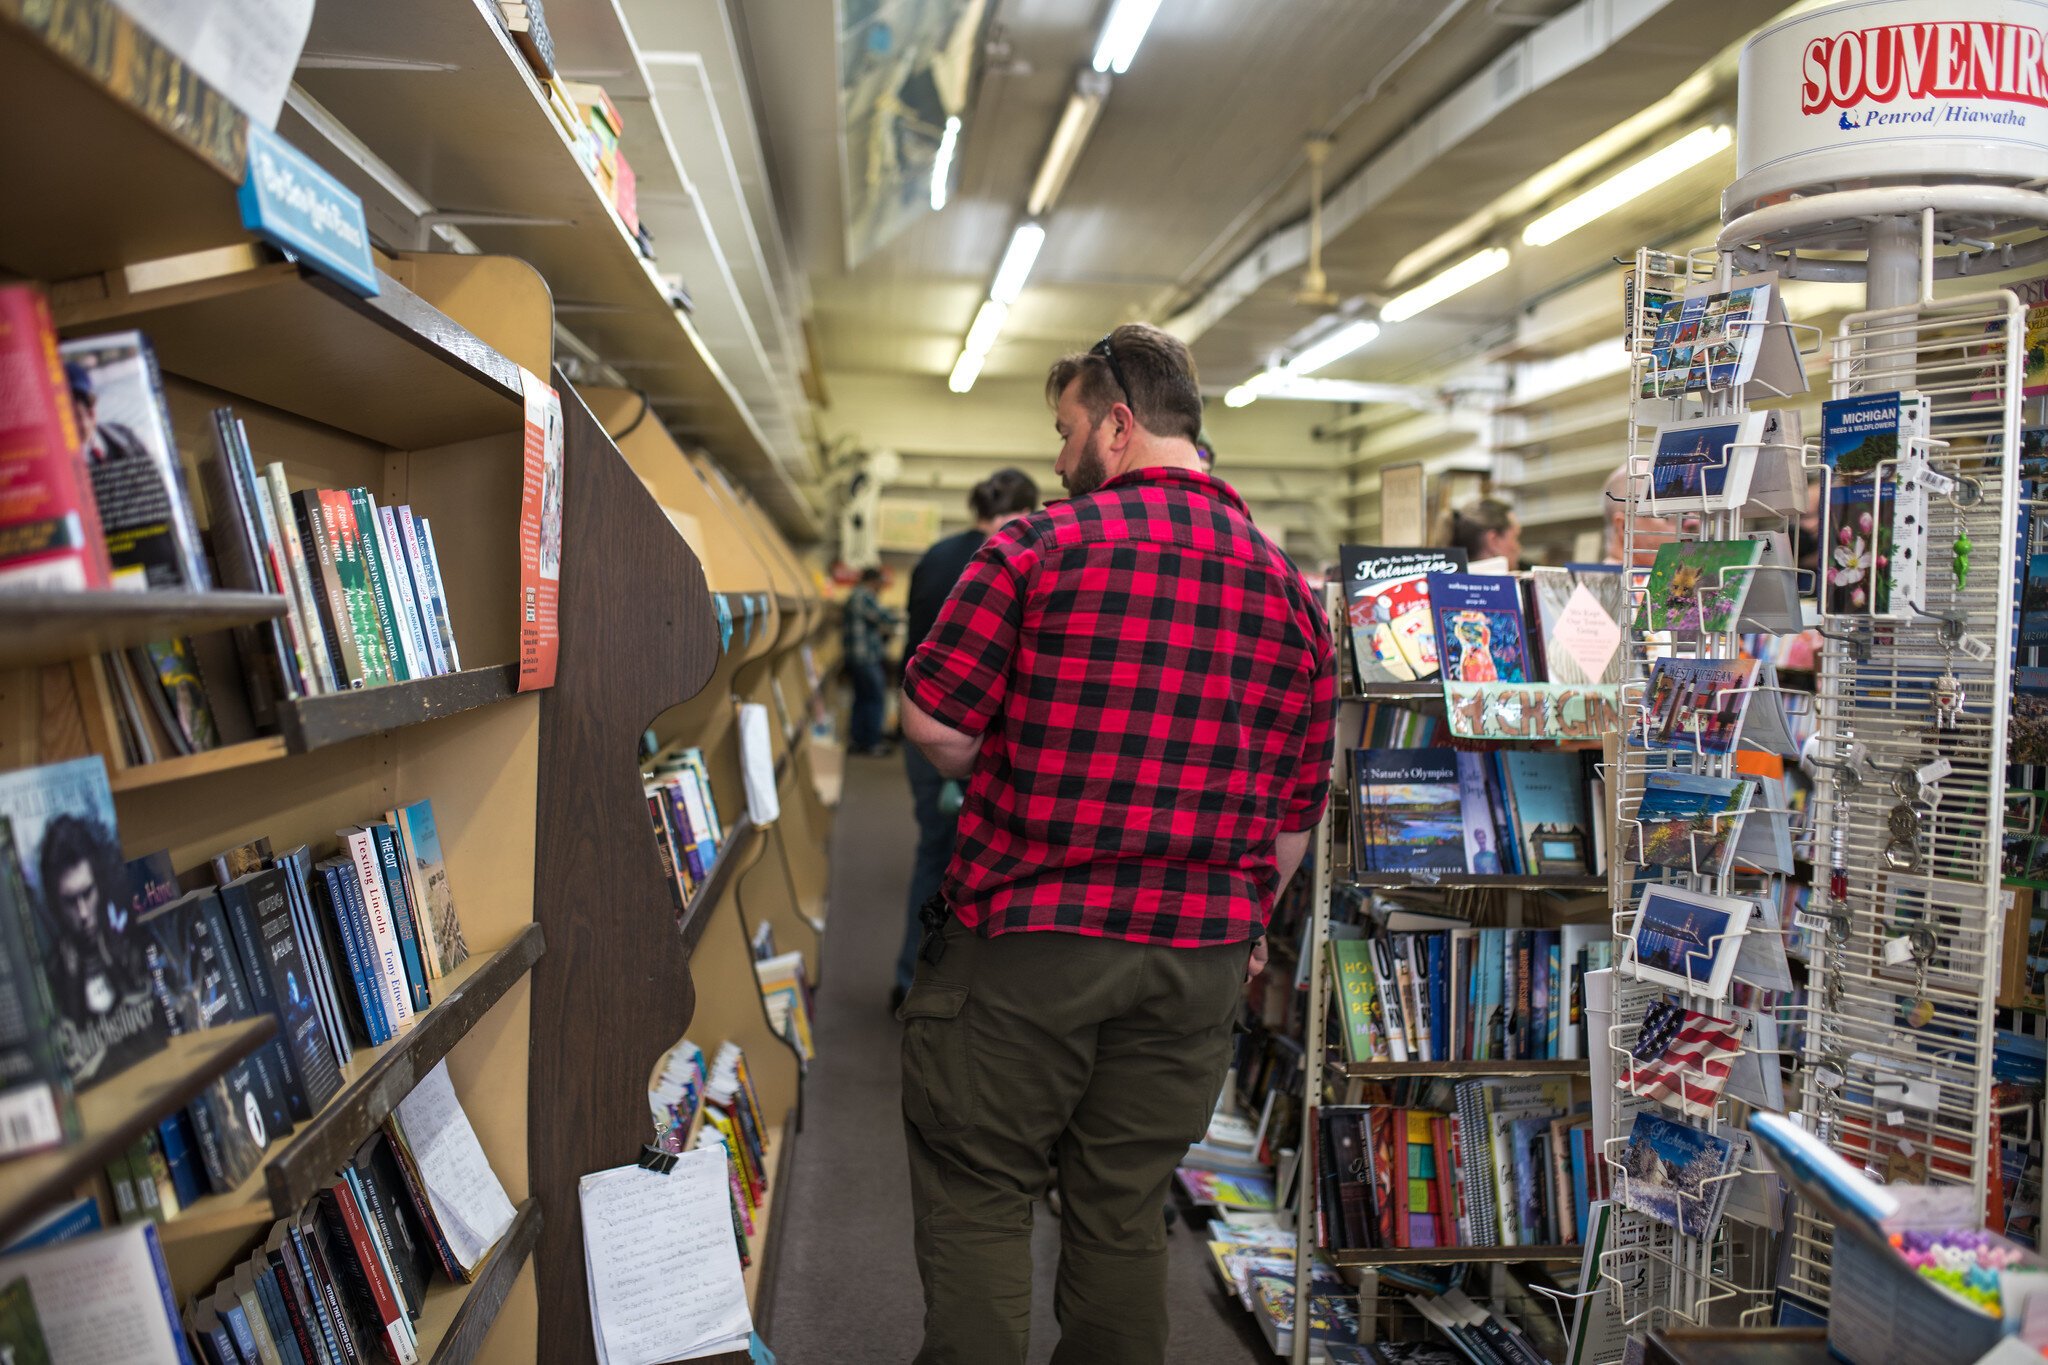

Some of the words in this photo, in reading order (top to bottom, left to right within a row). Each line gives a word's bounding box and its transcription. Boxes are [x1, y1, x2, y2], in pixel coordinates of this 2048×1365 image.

[1830, 427, 1847, 435] TREES
[1854, 421, 1896, 433] WILDFLOWERS
[1842, 408, 1896, 425] MICHIGAN
[311, 508, 324, 534] Letters
[318, 535, 326, 544] to
[385, 513, 393, 526] FIND
[389, 527, 397, 544] YOUR
[393, 544, 402, 561] VOICE
[403, 511, 411, 525] FIND
[407, 526, 415, 542] YOUR
[411, 542, 419, 559] VOICE
[2026, 523, 2035, 566] MICHIGAN
[319, 544, 332, 566] Corey
[361, 532, 378, 571] NEGROES
[371, 571, 380, 582] IN
[417, 536, 428, 557] Moon
[423, 563, 434, 582] Back
[429, 586, 438, 598] Me
[1355, 560, 1458, 580] Kalamazoo
[373, 583, 391, 625] MICHIGAN
[408, 606, 418, 631] DIANNA
[414, 631, 424, 652] LEEDER
[425, 604, 435, 628] DIANNA
[431, 628, 441, 649] LEEDER
[383, 626, 400, 663] HISTORY
[1669, 666, 1691, 680] WEST
[1693, 668, 1734, 682] MICHIGAN
[1371, 768, 1409, 780] Nature's
[1410, 767, 1454, 781] Olympics
[380, 837, 394, 854] THE
[383, 852, 398, 870] CUT
[389, 877, 404, 897] JOHN
[351, 911, 367, 948] CLOCKWORK
[353, 837, 378, 886] Texting
[367, 888, 390, 935] Lincoln
[380, 949, 399, 977] Tony
[390, 979, 410, 1019] Ettwein
[361, 915, 371, 931] OLD
[392, 897, 415, 941] WEMLINGER
[339, 916, 355, 953] CLOCKWORK
[1651, 1119, 1700, 1155] Michigan
[365, 1178, 372, 1186] WE
[367, 1185, 376, 1196] WERE
[371, 1195, 381, 1209] MEANT
[379, 1222, 390, 1237] GENTLE
[340, 1189, 352, 1208] NOTHING
[349, 1212, 361, 1231] DECLARE
[359, 1240, 373, 1263] ALEXANDER
[375, 1280, 388, 1301] MARQUART
[384, 1236, 395, 1251] PEOPLE
[274, 1268, 294, 1301] REVENGE
[324, 1283, 339, 1306] WITHIN
[288, 1302, 297, 1311] OF
[332, 1305, 342, 1318] THE
[232, 1313, 250, 1341] Randy
[245, 1299, 261, 1322] Randy
[257, 1331, 275, 1361] Pearson
[291, 1312, 303, 1327] THE
[335, 1318, 351, 1343] LIGHTED
[217, 1333, 236, 1362] RANDY
[344, 1342, 355, 1357] CITY
